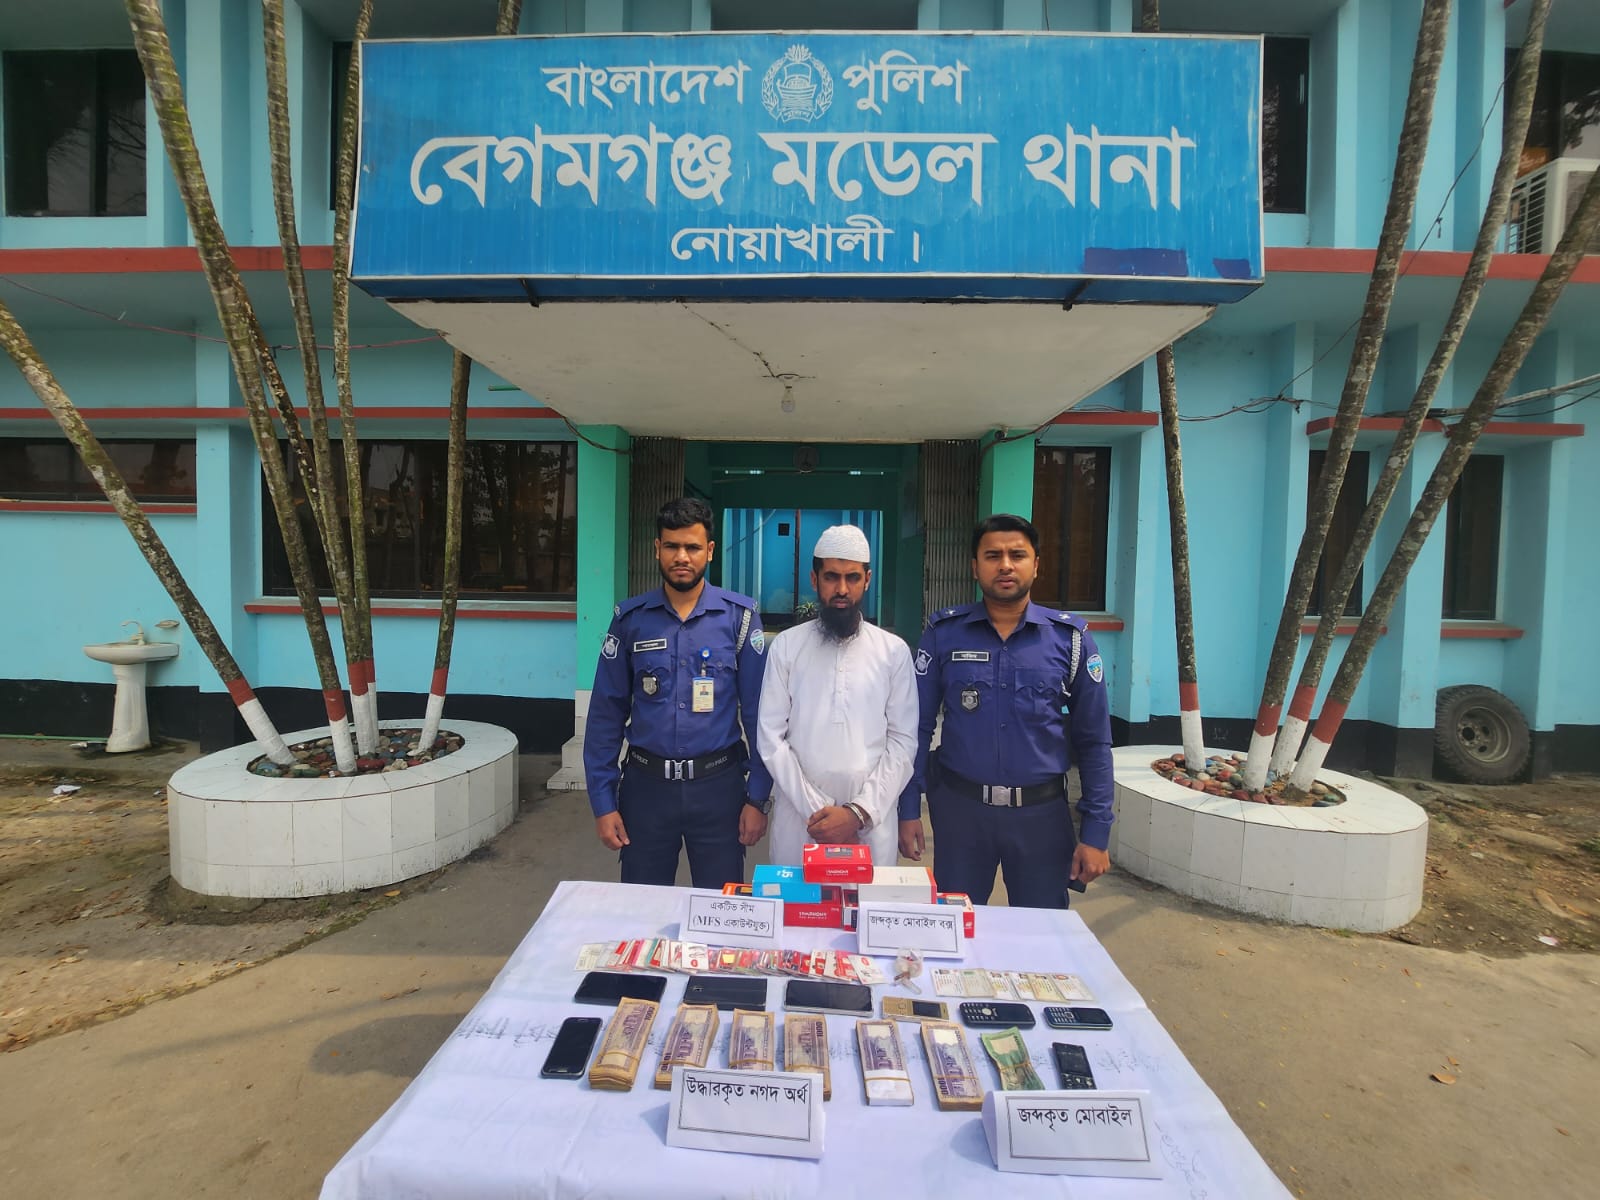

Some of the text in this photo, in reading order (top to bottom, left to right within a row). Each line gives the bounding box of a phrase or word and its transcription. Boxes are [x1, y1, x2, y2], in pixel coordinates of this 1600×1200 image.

[541, 49, 970, 115] বাংলাদেশ পুলিশ
[410, 121, 1197, 210] বেগমগঞ্জ মডেল থানা
[670, 214, 894, 263] নোয়াখালী
[692, 915, 721, 927] (MFS
[902, 915, 936, 928] মোবাইল
[685, 1077, 808, 1105] উদ্ধারকৃত নগদ অর্থ
[1017, 1103, 1133, 1132] জব্দকৃত মোবাইল
